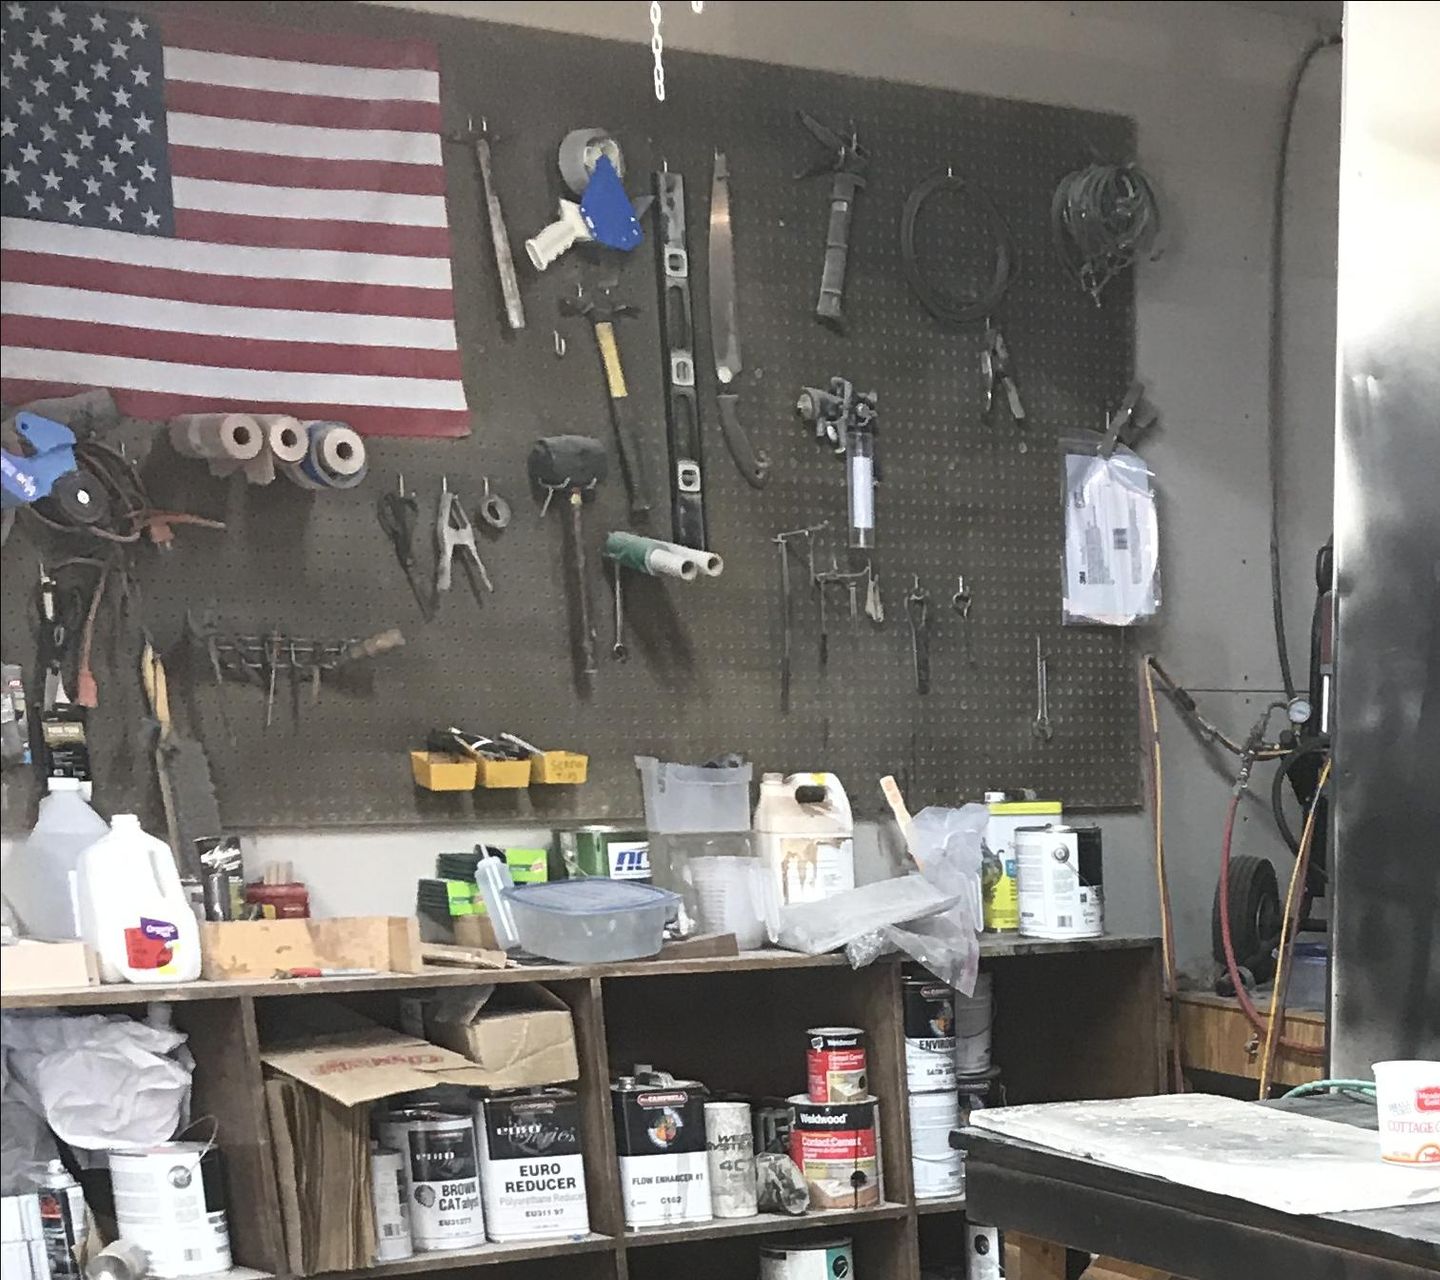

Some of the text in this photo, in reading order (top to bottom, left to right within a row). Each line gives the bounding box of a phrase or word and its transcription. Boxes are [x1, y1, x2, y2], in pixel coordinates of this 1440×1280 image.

[1387, 1119, 1434, 1134] COTTAGE
[519, 1162, 562, 1178] EURO
[505, 1177, 577, 1194] REDUCER
[631, 1175, 653, 1186] FLOW
[655, 1173, 694, 1185] ENHANCER
